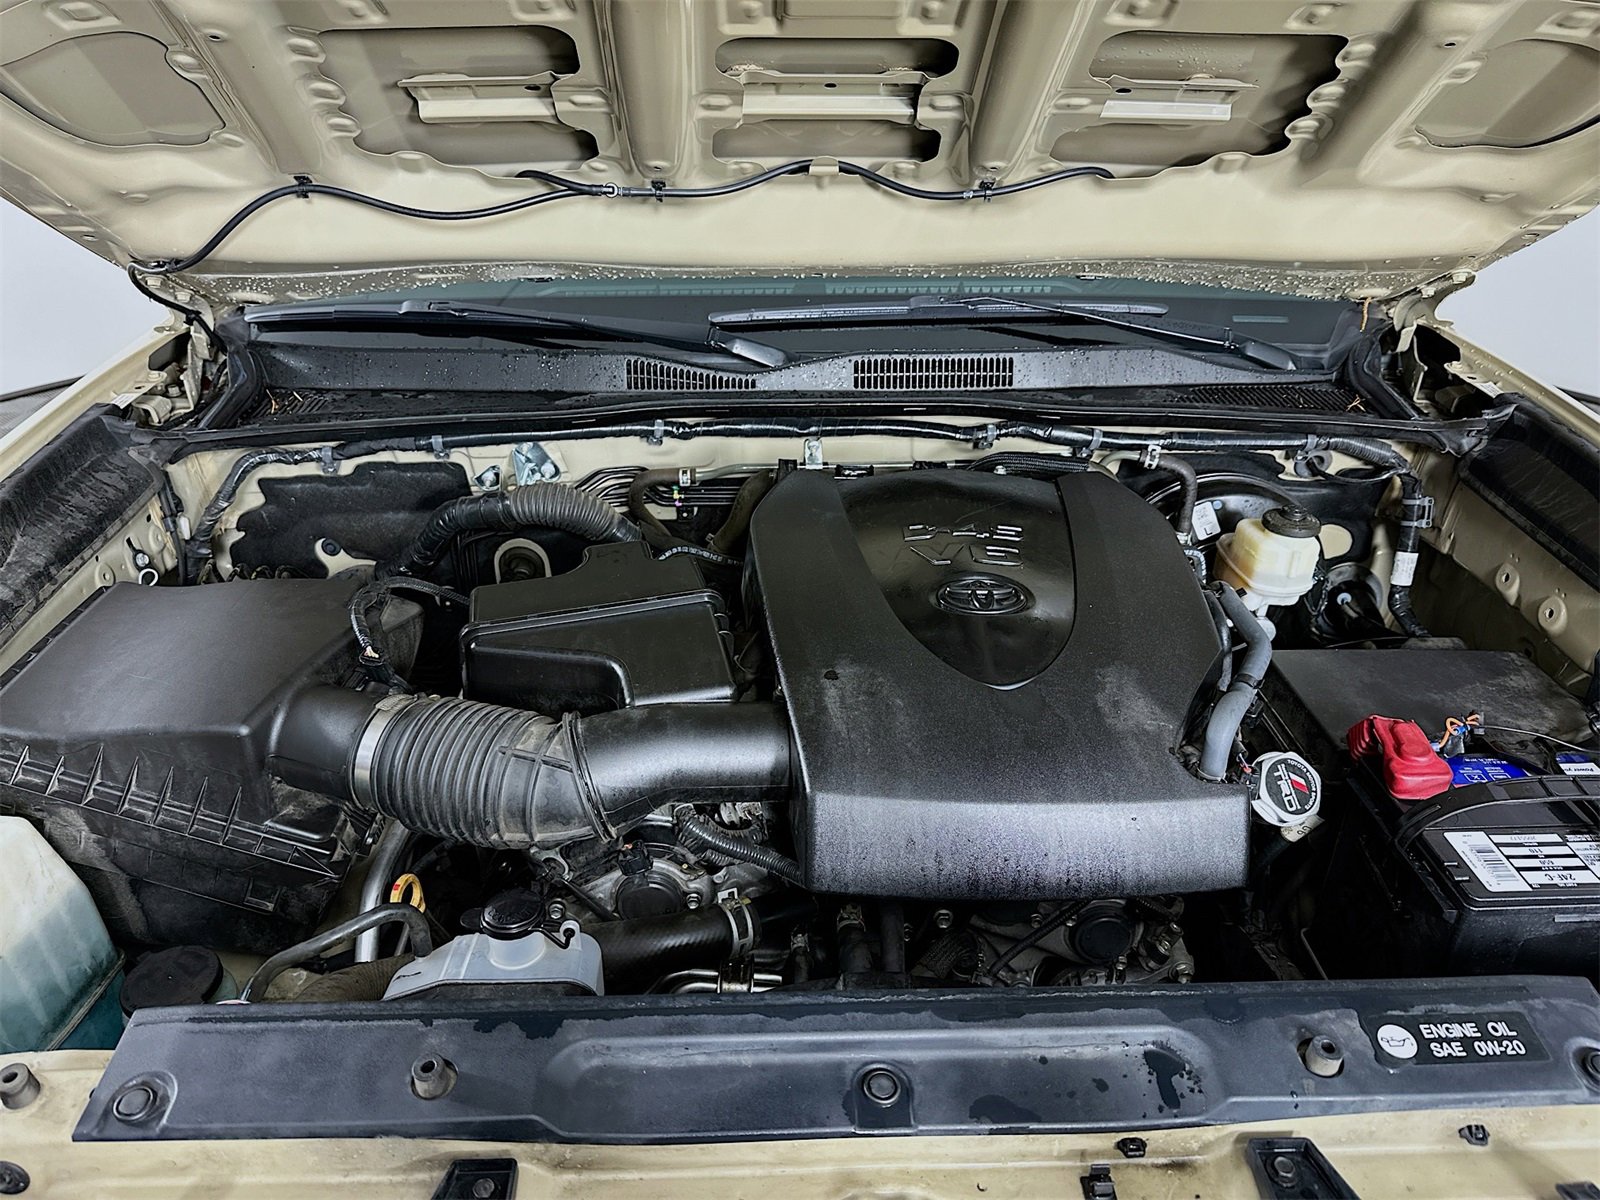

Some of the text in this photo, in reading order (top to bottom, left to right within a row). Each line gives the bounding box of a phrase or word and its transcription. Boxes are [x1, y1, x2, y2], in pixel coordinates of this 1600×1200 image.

[909, 542, 1024, 567] V6
[1273, 764, 1298, 812] TRD
[1287, 759, 1317, 811] TOYOTA MOTOR SPORTS
[1418, 1021, 1518, 1039] ENGINE OIL
[1429, 1039, 1527, 1058] SAE 0W-20
